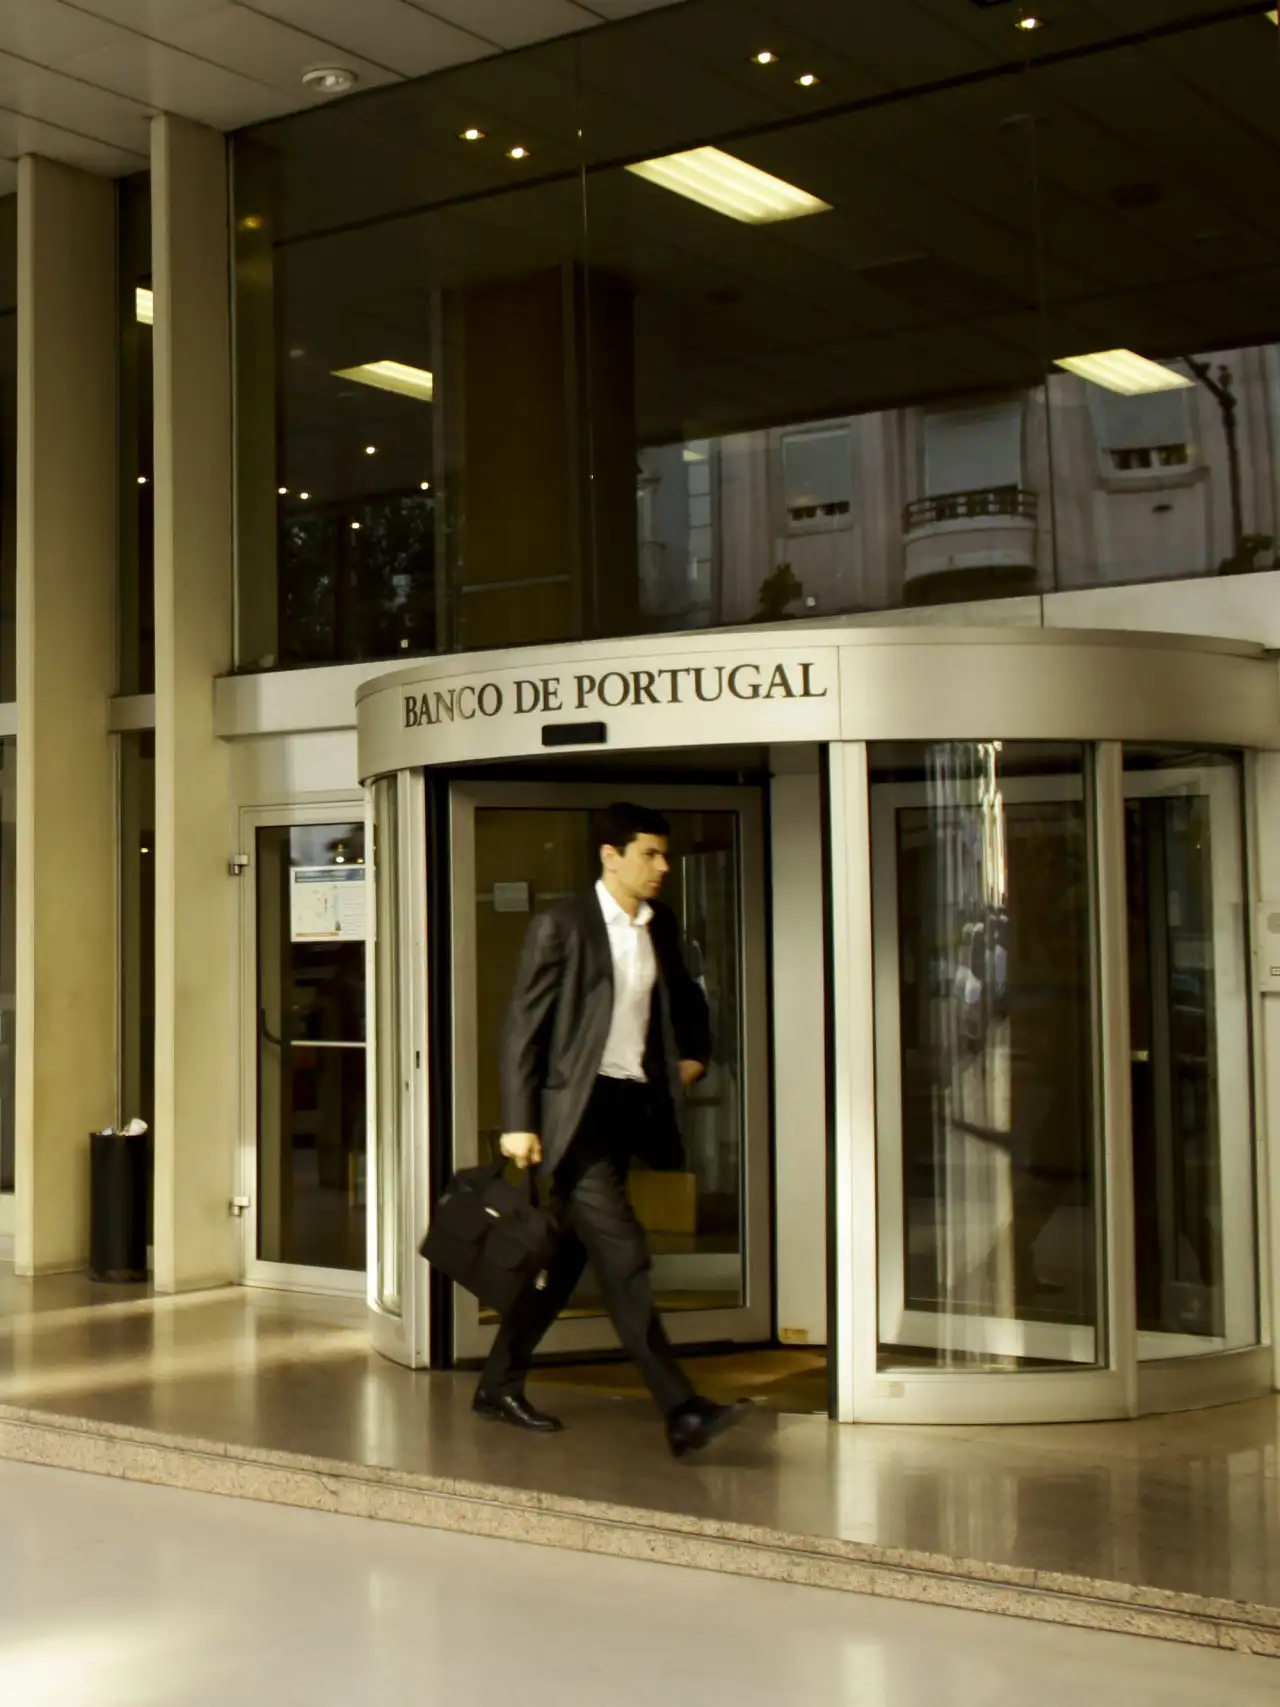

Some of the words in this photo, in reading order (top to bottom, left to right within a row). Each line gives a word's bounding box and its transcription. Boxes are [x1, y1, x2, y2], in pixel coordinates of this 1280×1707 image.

[404, 683, 503, 728] BANCO
[513, 677, 564, 714] DE
[574, 662, 828, 709] PORTUGAL
